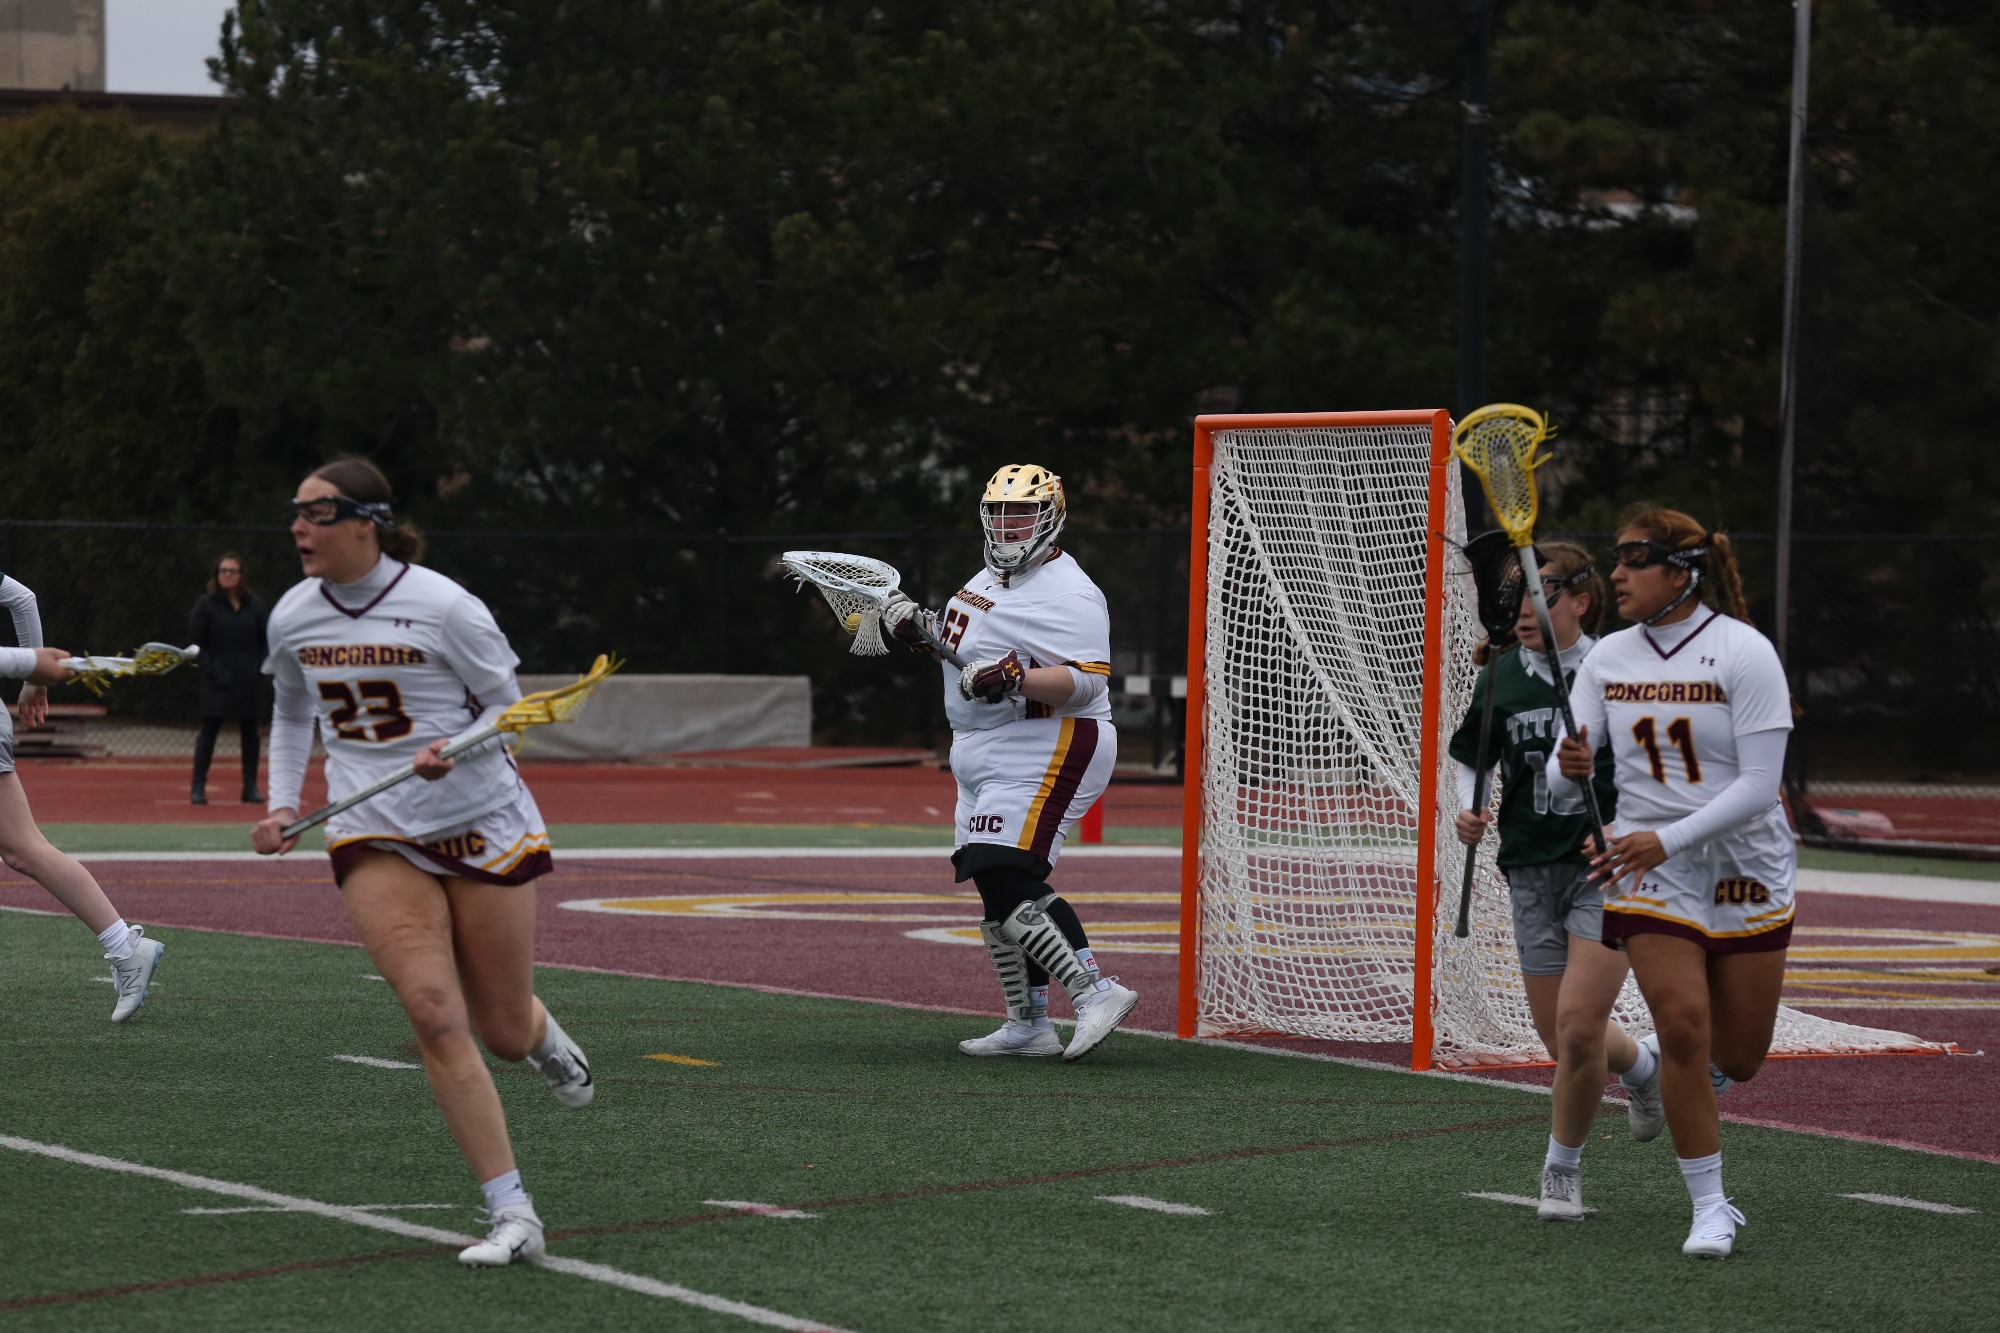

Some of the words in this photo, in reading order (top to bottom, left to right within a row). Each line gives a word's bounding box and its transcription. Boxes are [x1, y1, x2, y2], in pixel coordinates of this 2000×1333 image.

[1603, 680, 1729, 704] CONCORDIA
[316, 679, 414, 742] 23
[1631, 716, 1702, 785] 11
[969, 814, 1005, 835] CUC
[1714, 878, 1770, 907] CUC
